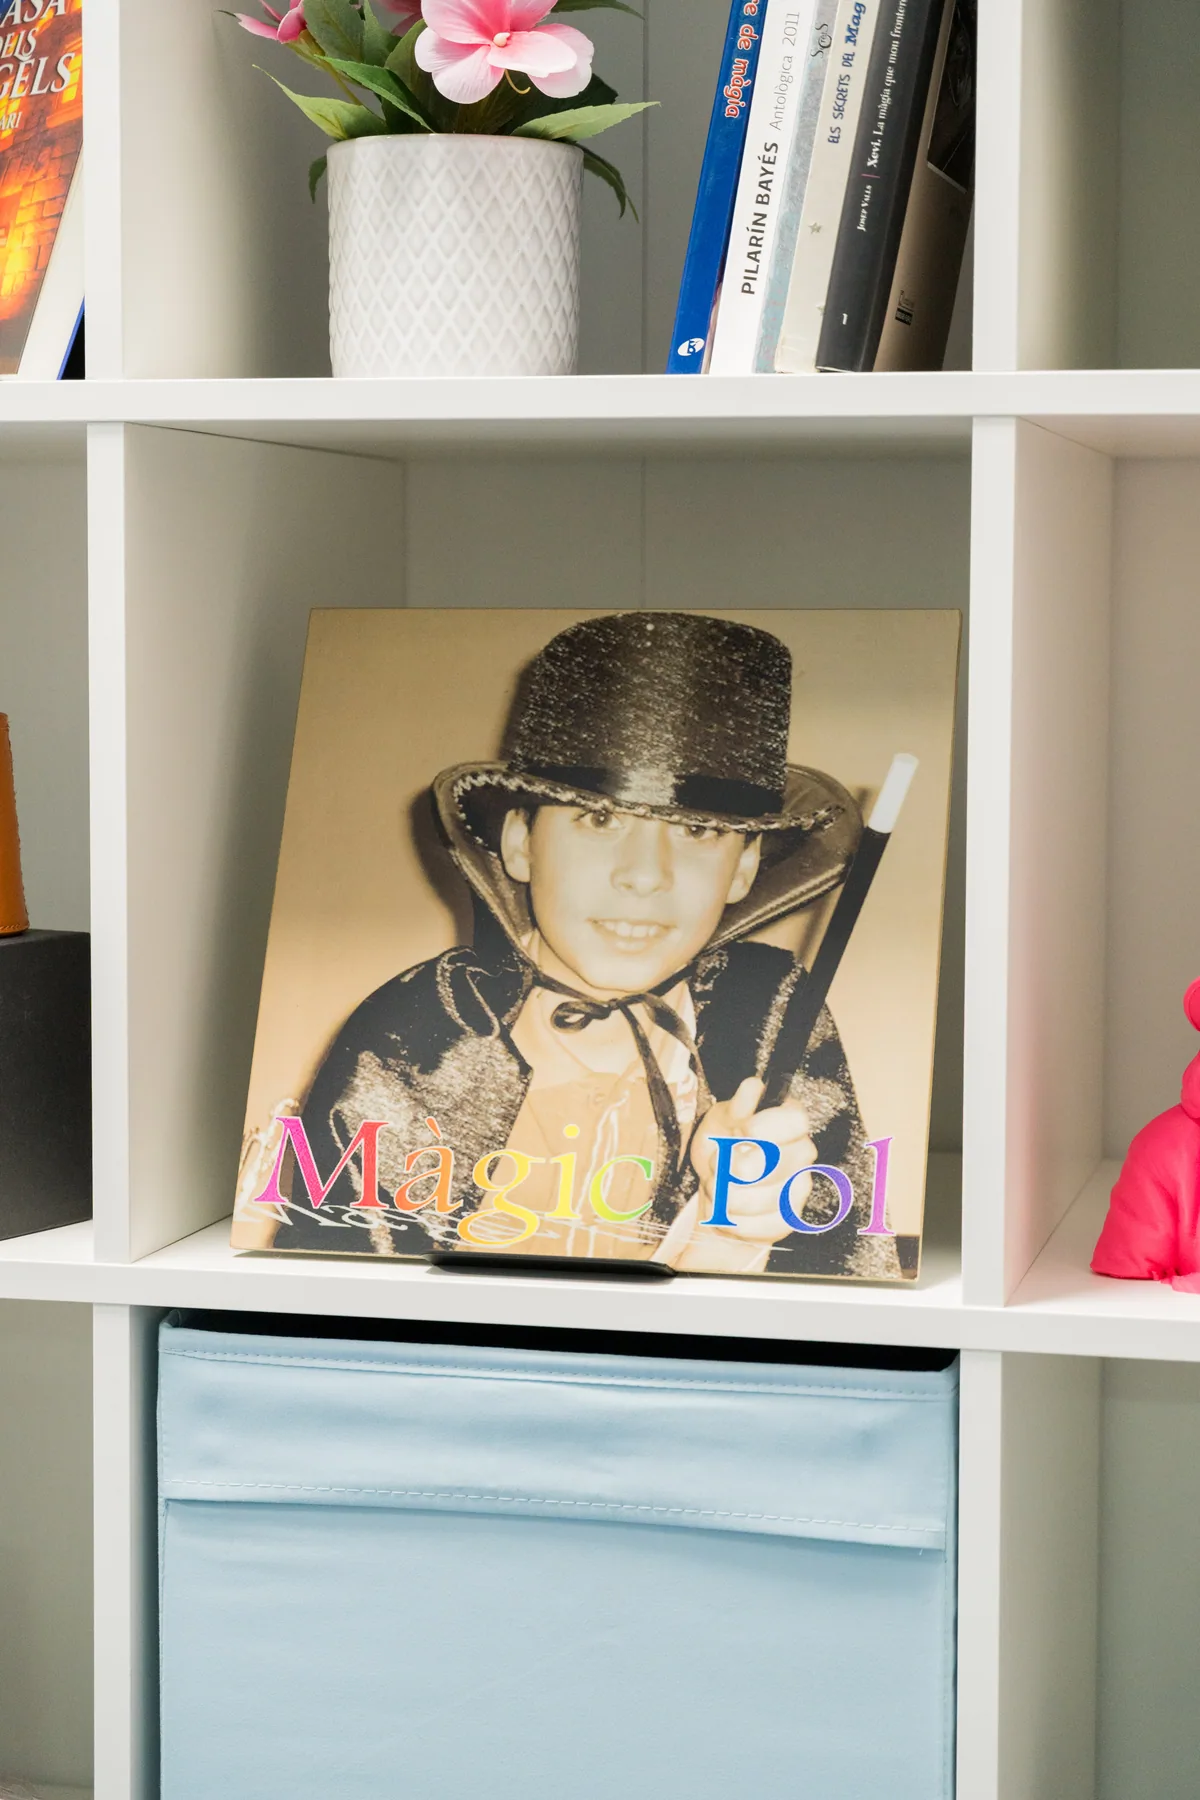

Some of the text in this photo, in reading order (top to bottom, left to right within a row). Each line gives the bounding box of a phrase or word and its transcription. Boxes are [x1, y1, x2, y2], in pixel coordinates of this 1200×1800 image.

[0, 27, 39, 62] ELS
[737, 24, 759, 50] de
[841, 52, 856, 68] DEL
[889, 41, 900, 64] mou
[723, 58, 751, 118] màgia
[885, 66, 896, 87] que
[833, 74, 851, 120] SECRETS
[828, 126, 841, 144] ELS
[872, 121, 885, 136] La
[741, 12, 800, 295] PILARÍN BAYÉS Antològica 2011
[866, 139, 882, 168] Xevi.
[253, 1115, 896, 1246] Màgic Pol
